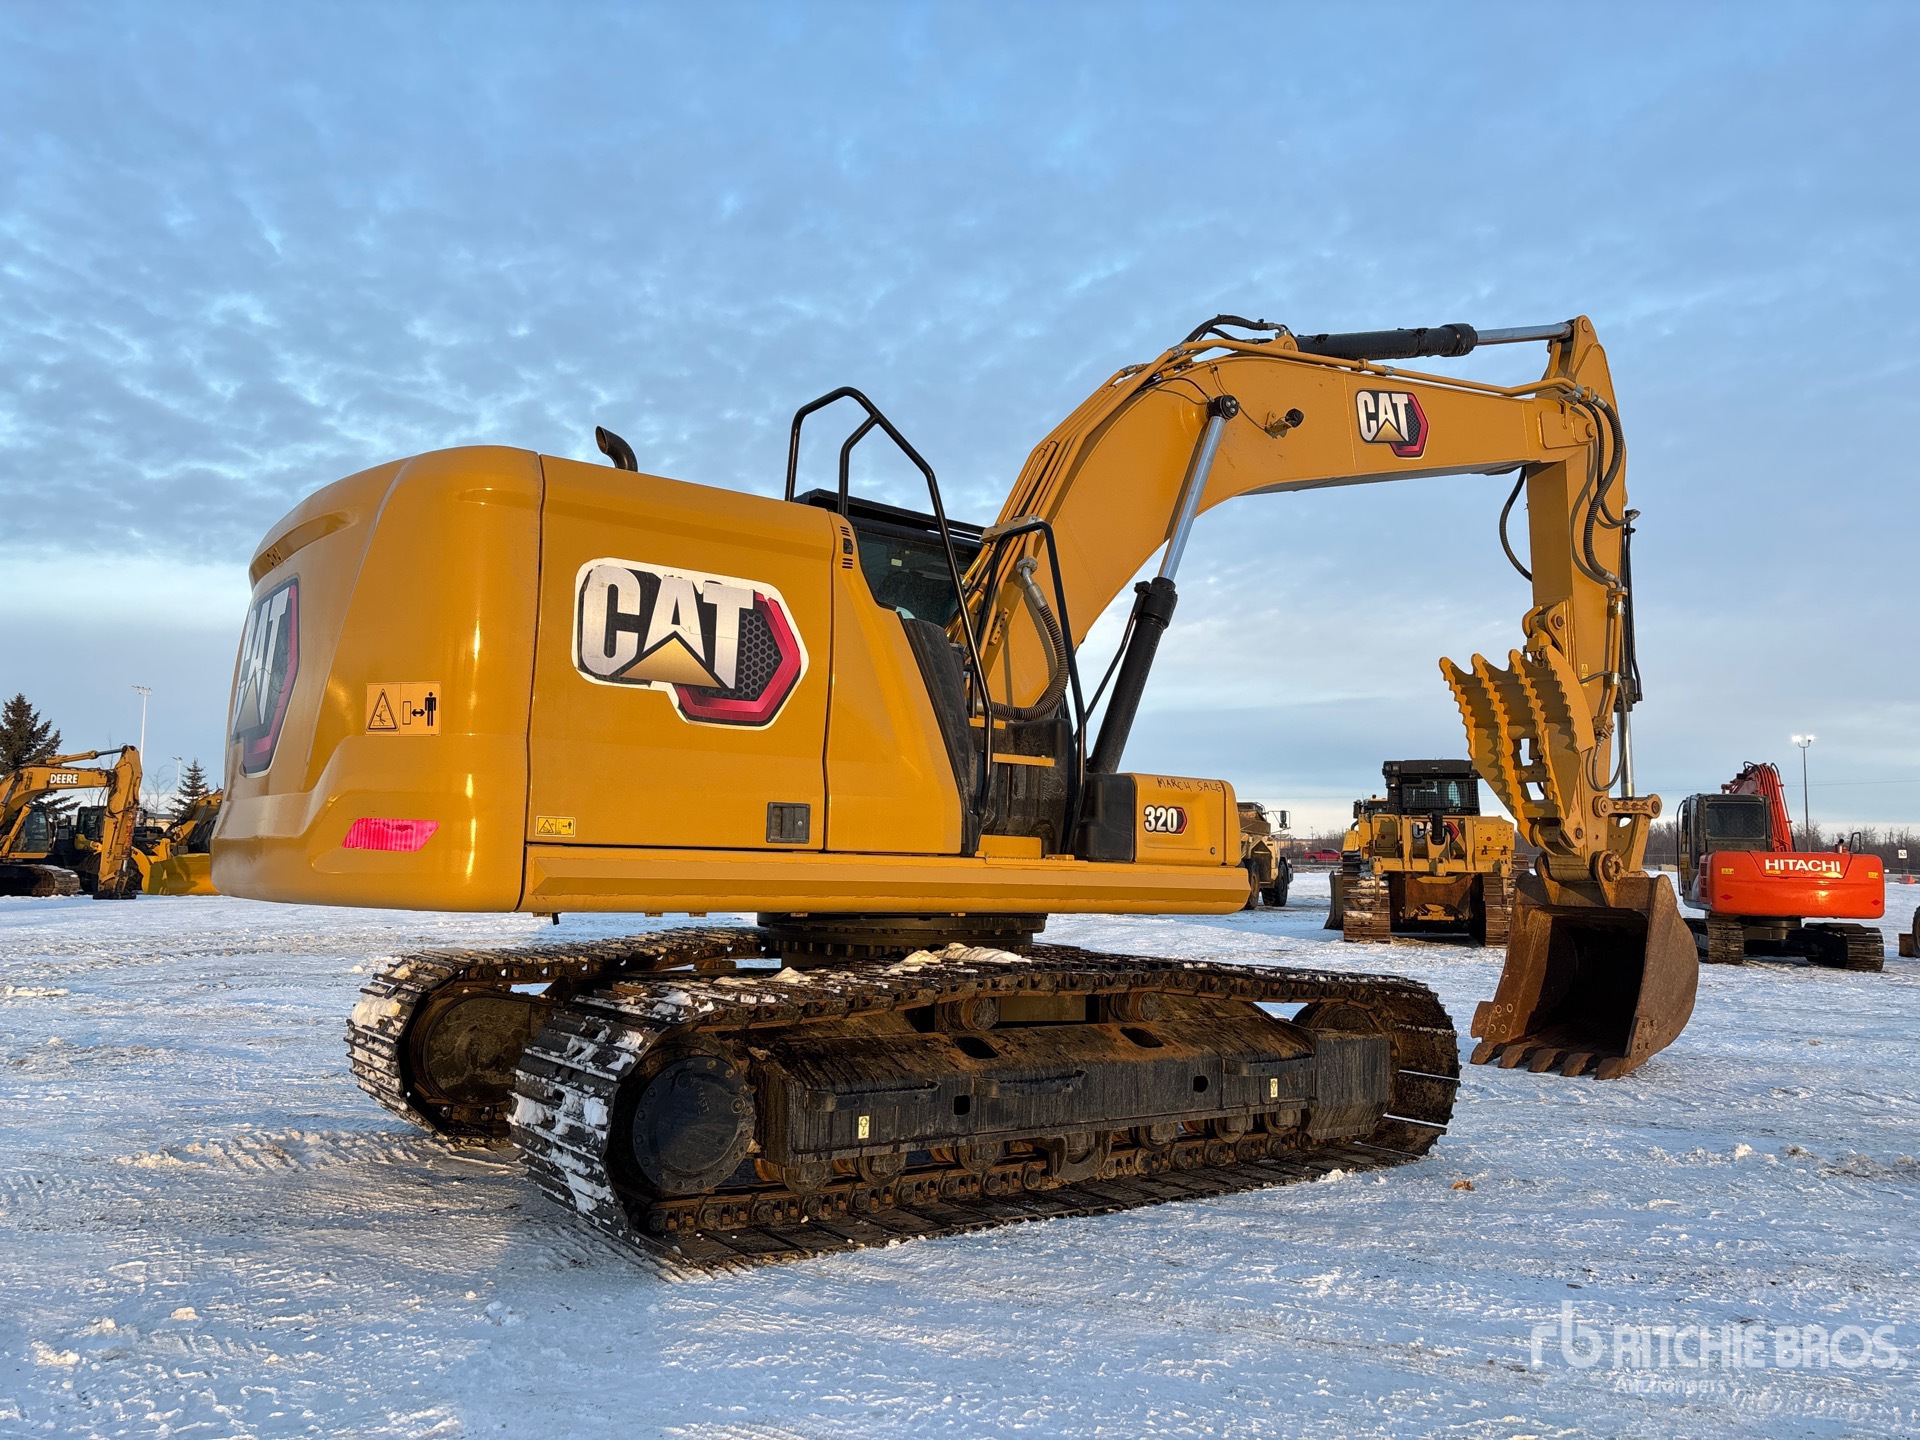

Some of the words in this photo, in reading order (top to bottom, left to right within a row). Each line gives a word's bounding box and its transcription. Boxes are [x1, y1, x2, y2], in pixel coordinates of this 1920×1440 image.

[1357, 391, 1409, 441] CAT
[582, 564, 754, 690] CAT
[231, 587, 290, 736] CAT
[50, 773, 78, 784] DEERE
[1157, 777, 1192, 792] MARCH
[1197, 780, 1221, 792] SALE
[1144, 806, 1178, 832] 320
[1765, 859, 1840, 872] HITACHI
